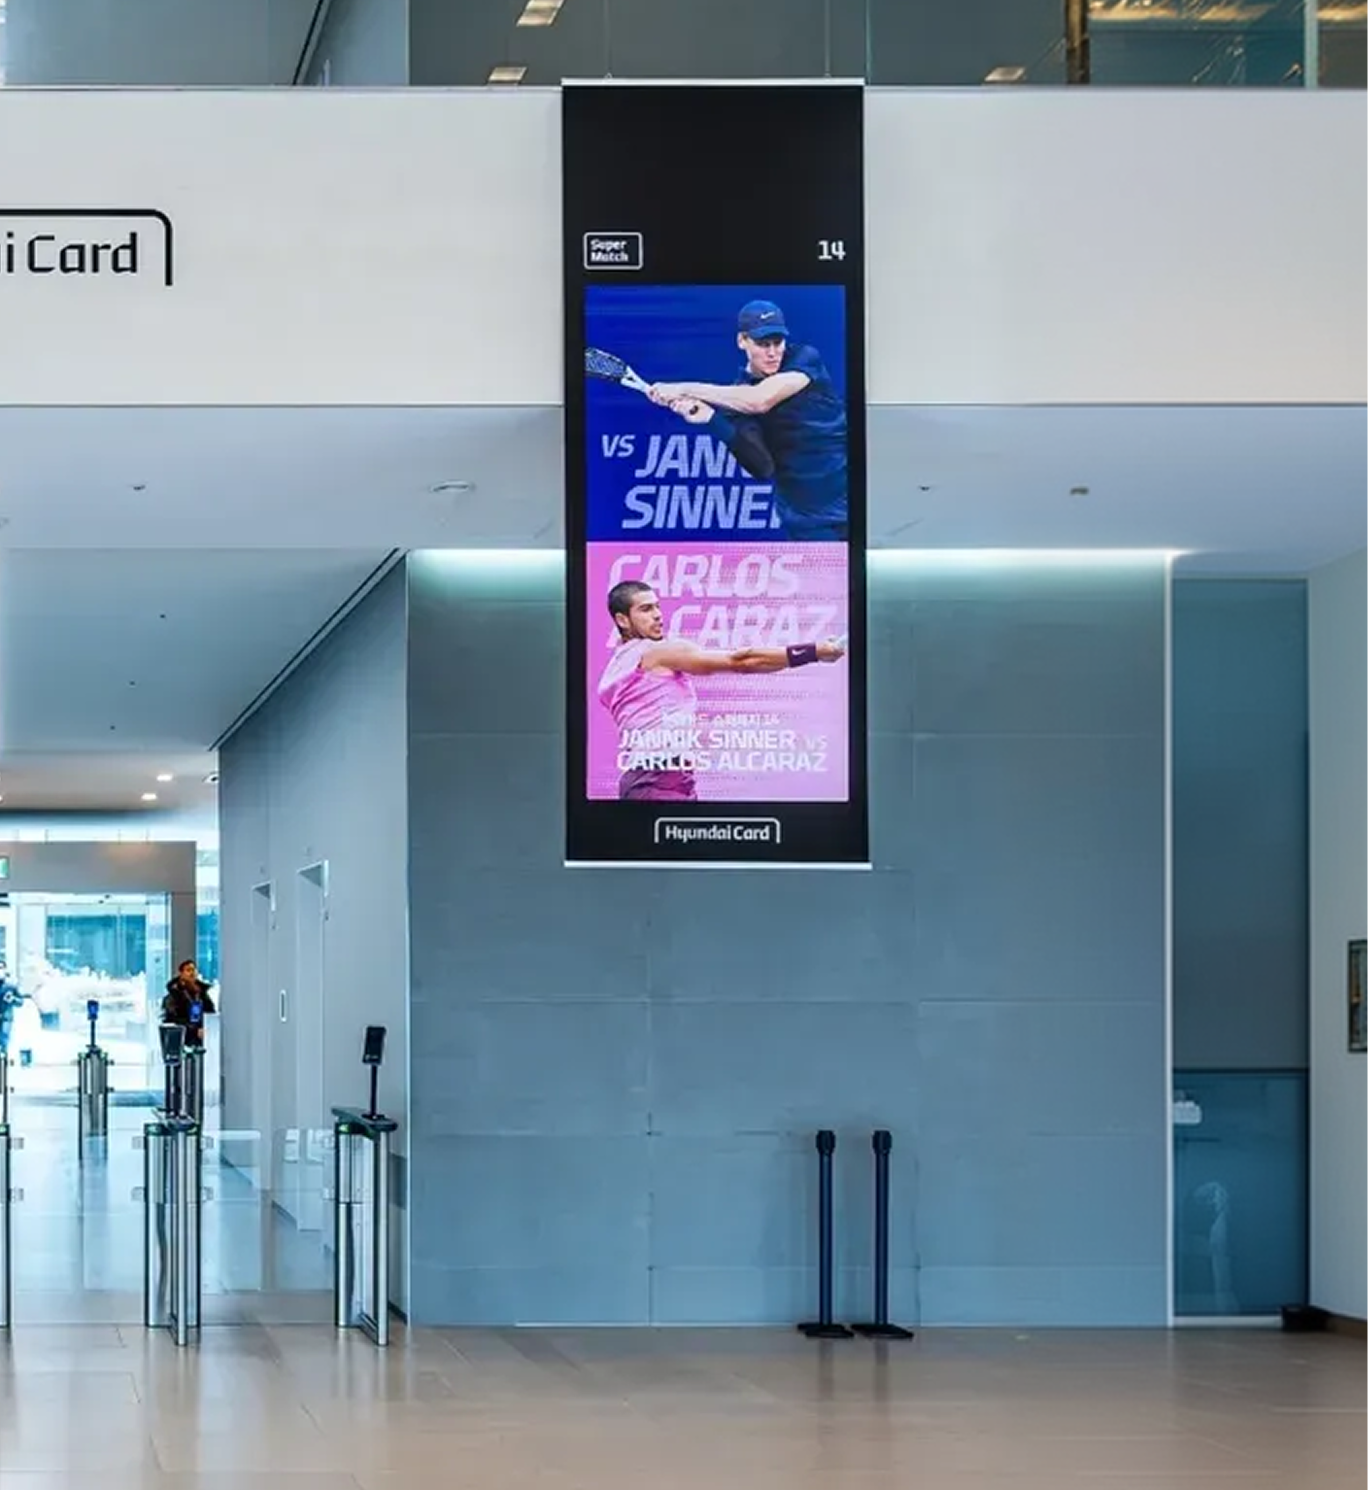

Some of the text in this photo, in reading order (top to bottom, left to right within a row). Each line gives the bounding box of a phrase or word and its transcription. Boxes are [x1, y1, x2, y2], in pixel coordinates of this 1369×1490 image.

[27, 231, 139, 274] Card
[817, 240, 847, 261] 14
[602, 434, 636, 458] VS
[606, 604, 837, 651] CARAZ
[617, 729, 702, 750] JANNIK
[708, 729, 796, 750] SINNER
[616, 751, 828, 773] CARLOS ALCARAZ
[665, 825, 770, 842] Hyundai Card
